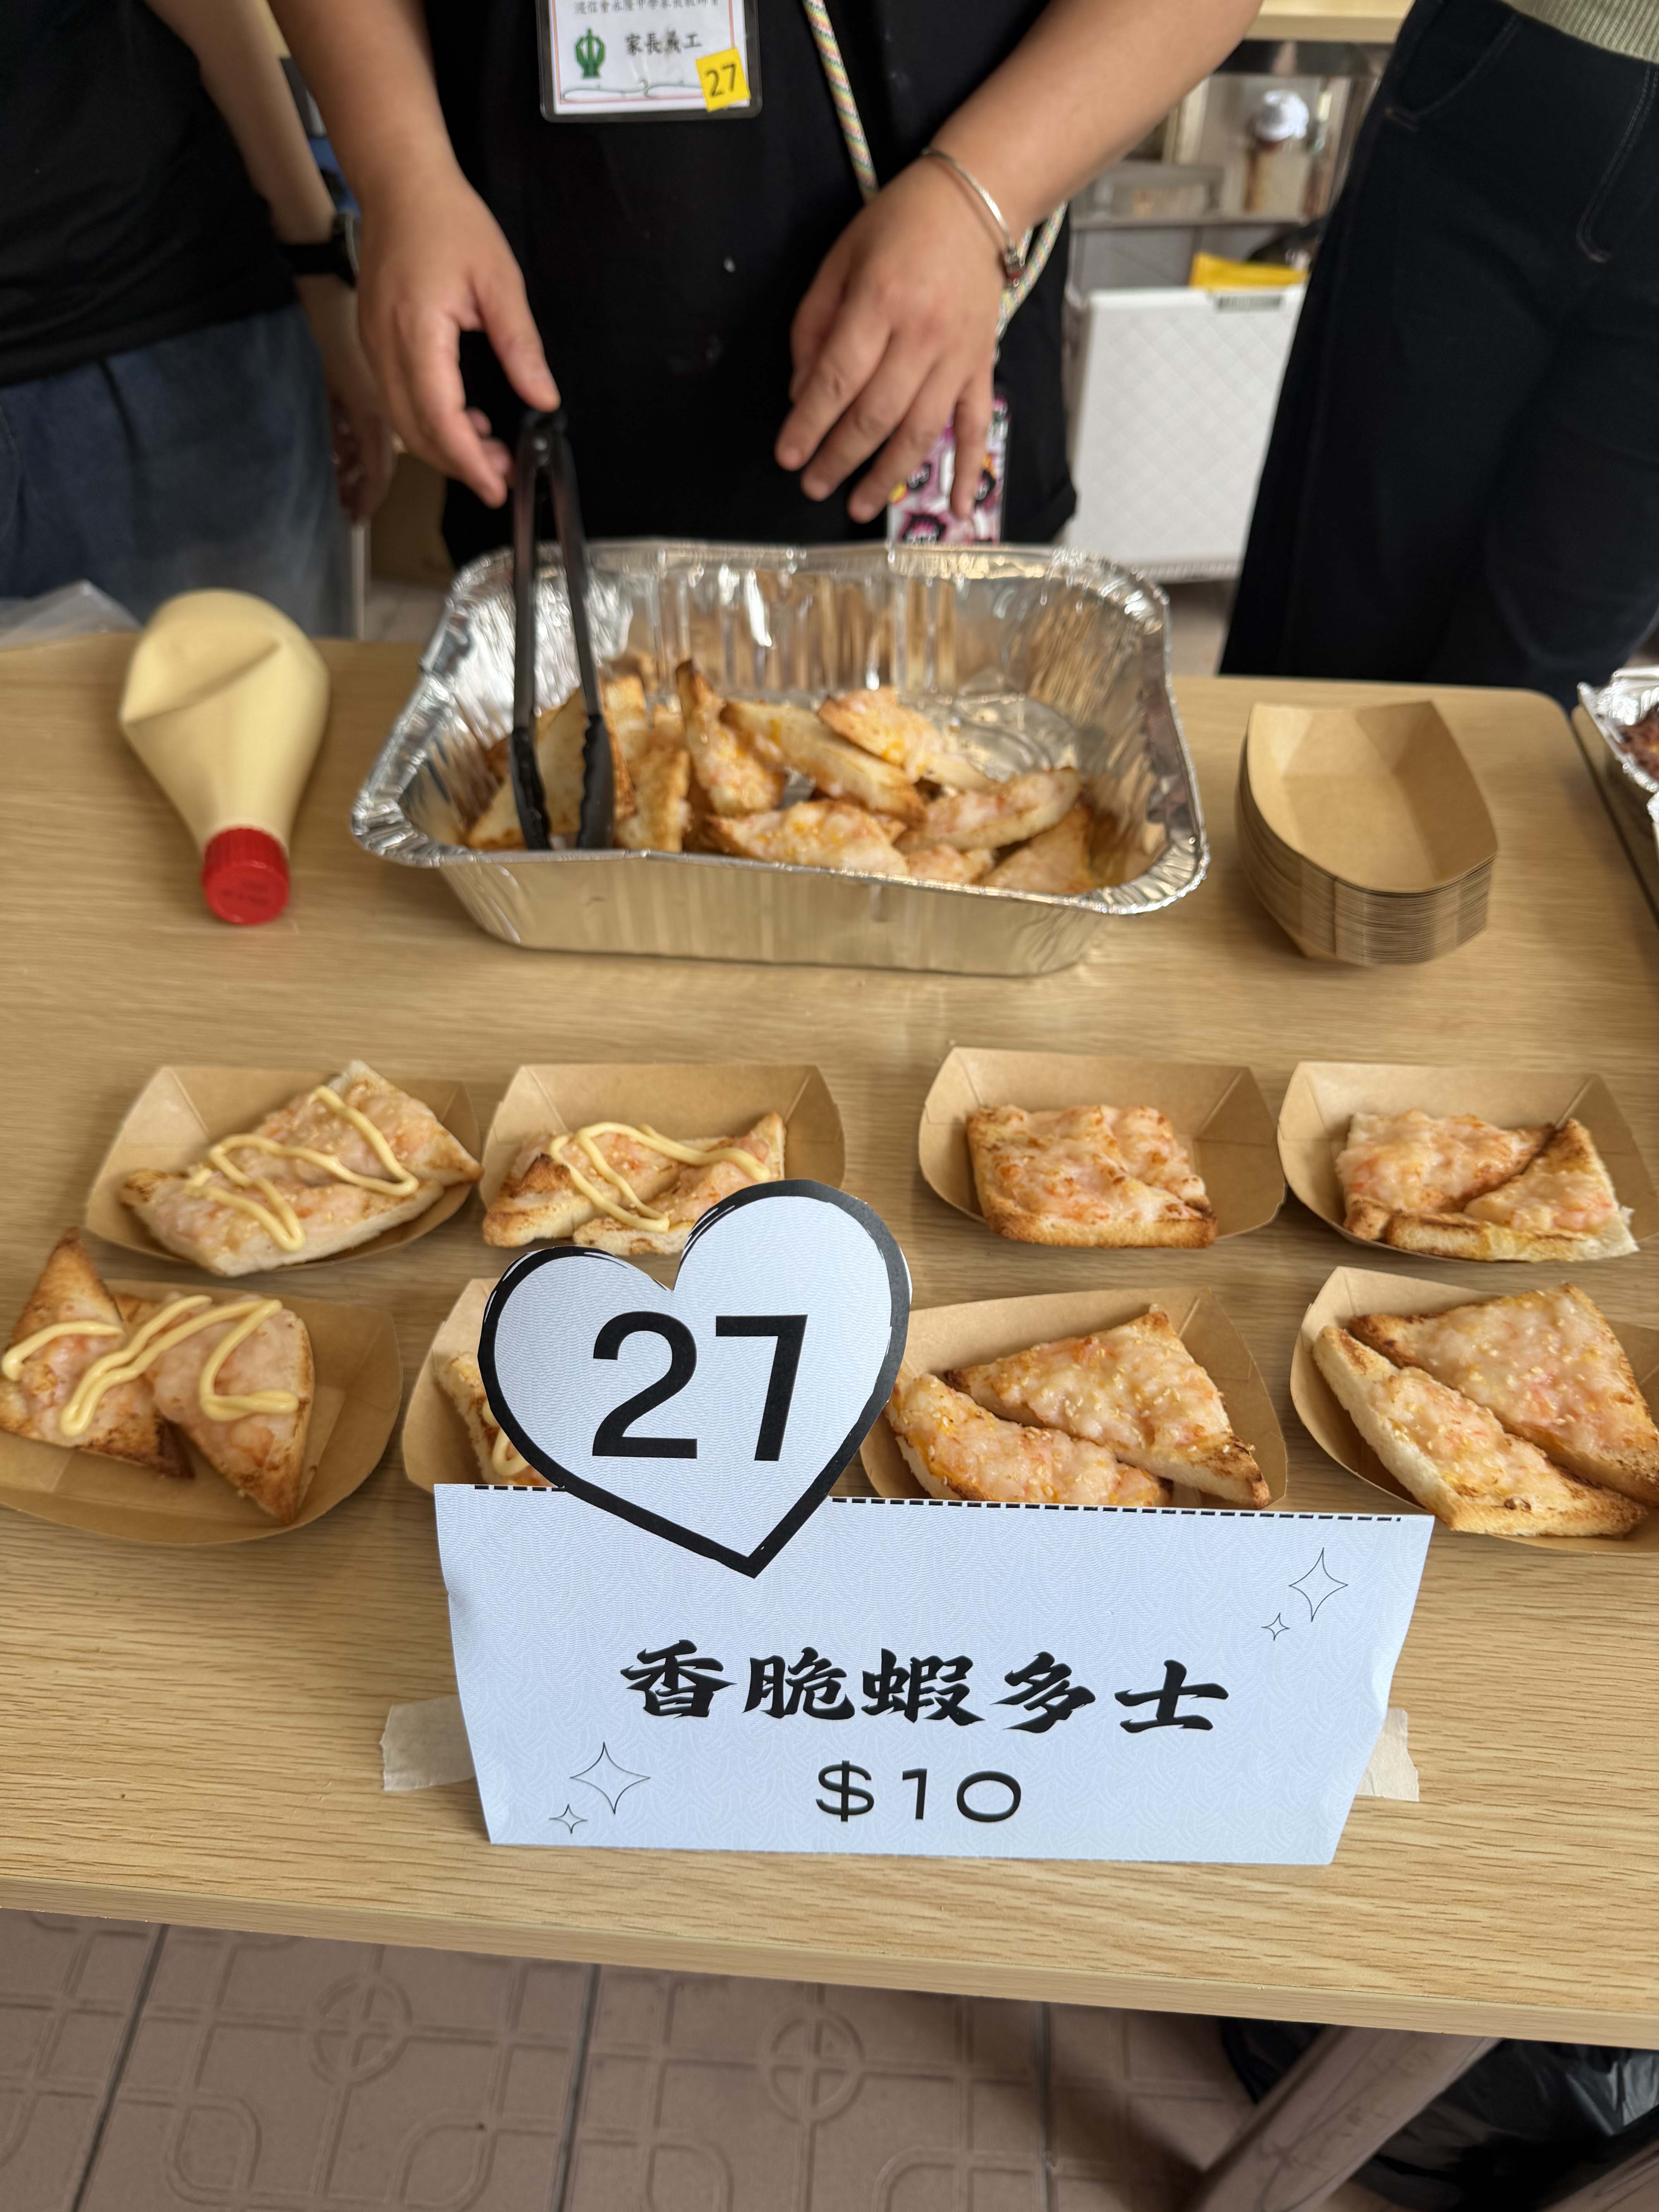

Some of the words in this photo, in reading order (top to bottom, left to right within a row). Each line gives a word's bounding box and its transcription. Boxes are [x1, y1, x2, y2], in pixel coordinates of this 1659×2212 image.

[706, 63, 737, 97] 27
[592, 1311, 808, 1462] 27
[620, 1639, 1229, 1733] 香脆蝦多士
[816, 1760, 1022, 1823] $10
